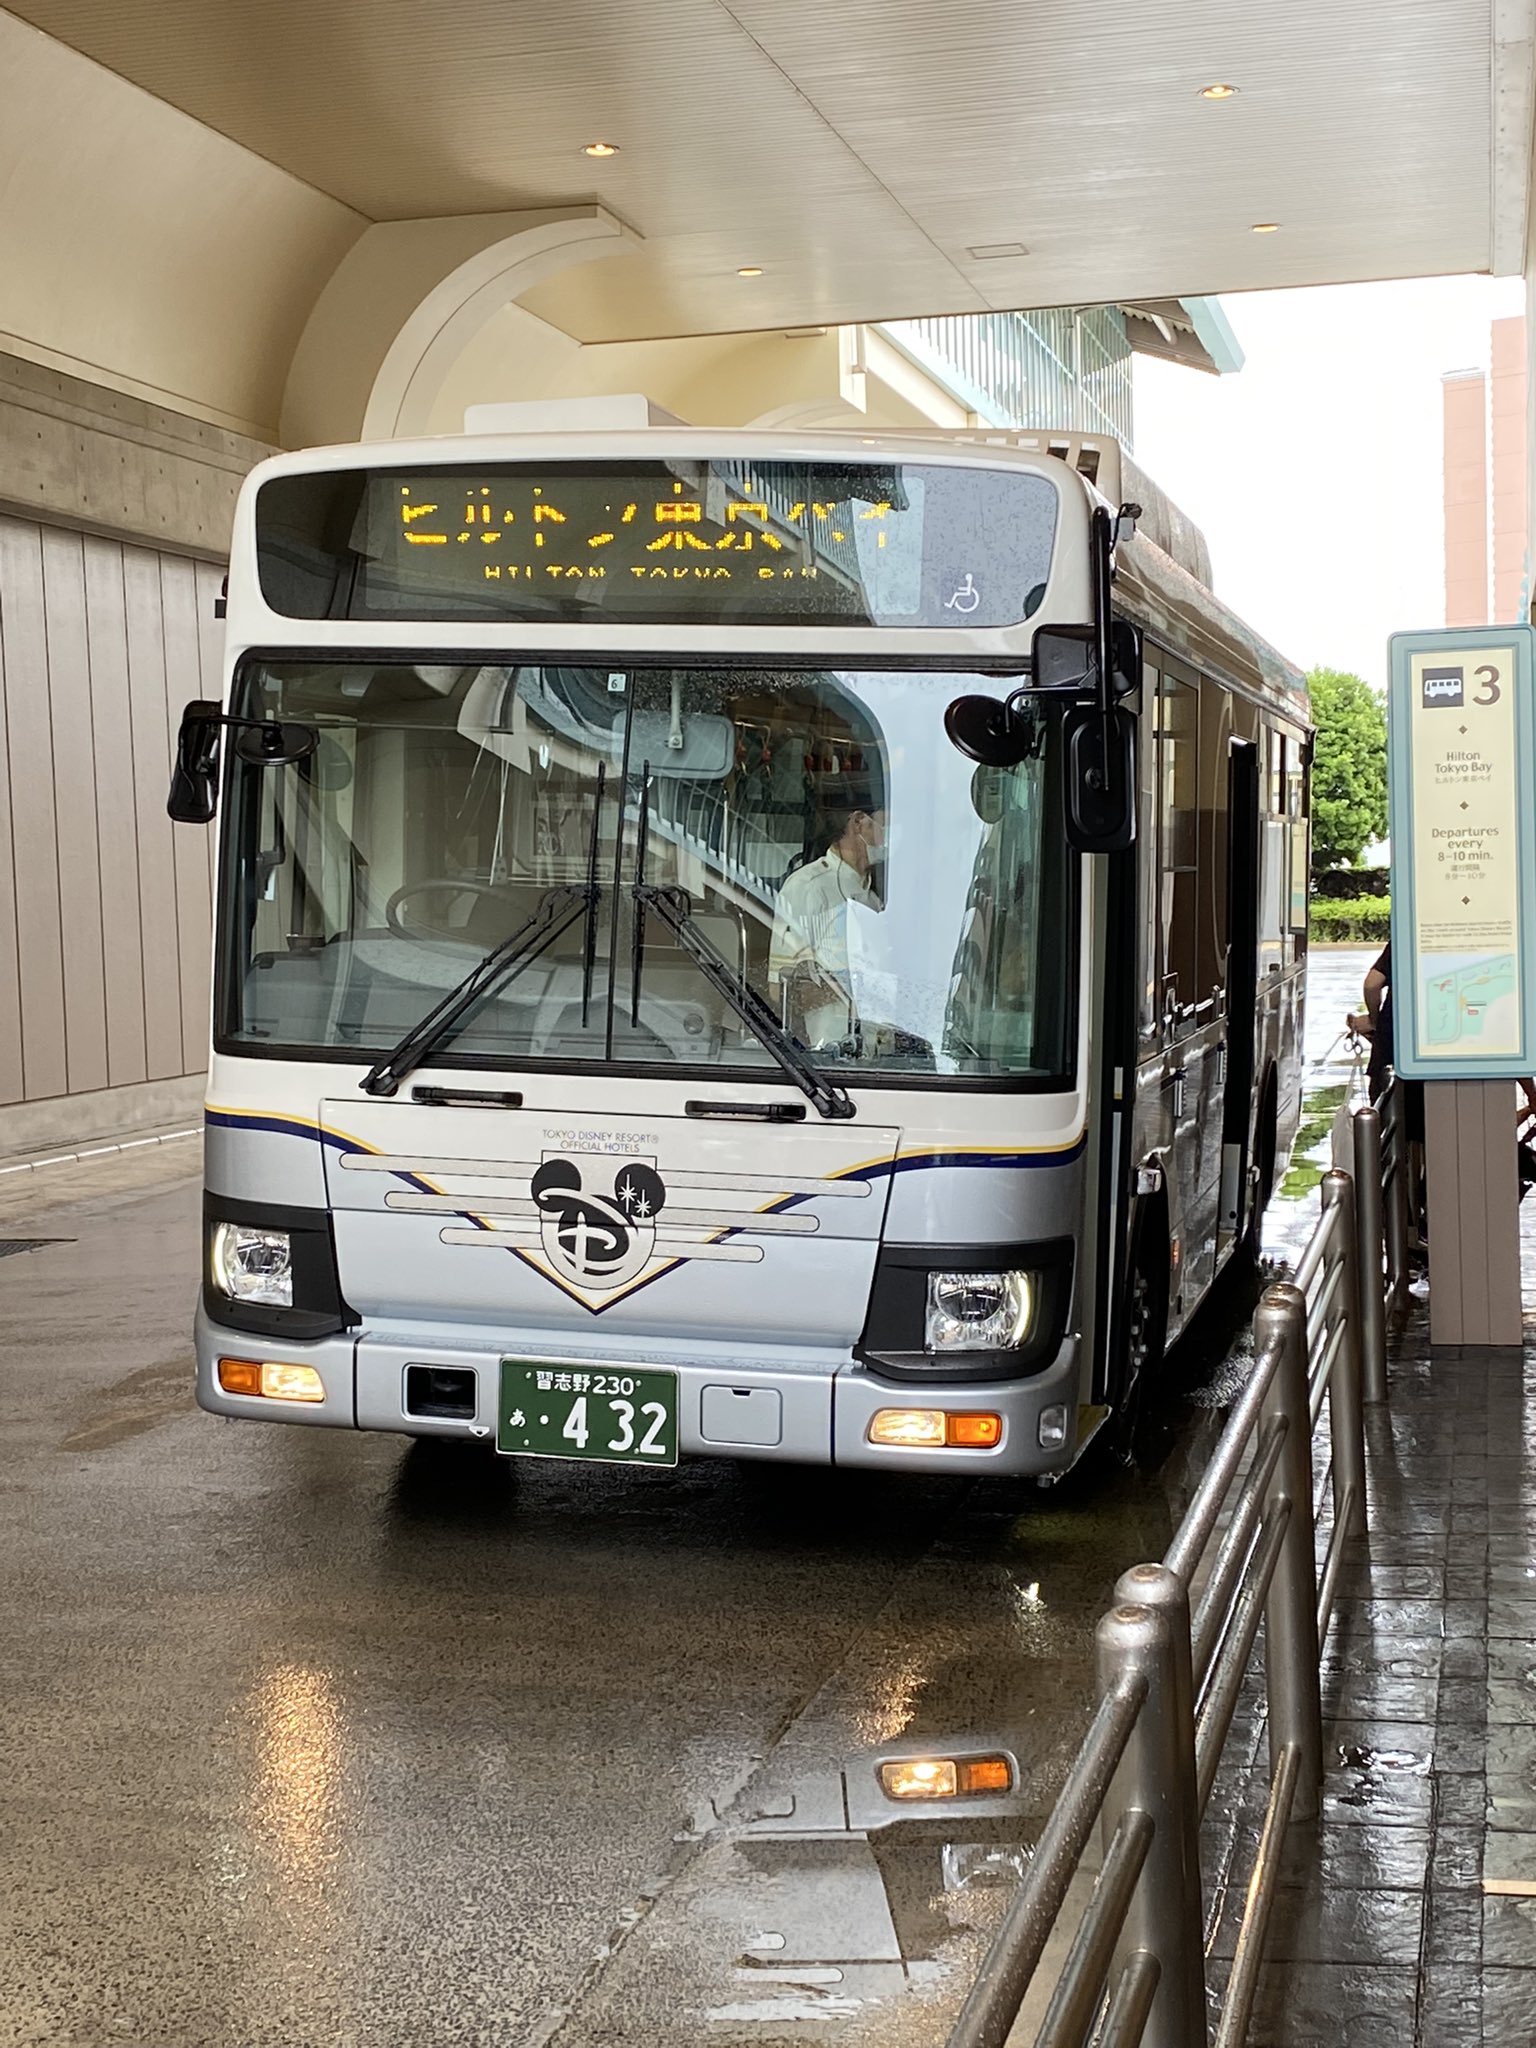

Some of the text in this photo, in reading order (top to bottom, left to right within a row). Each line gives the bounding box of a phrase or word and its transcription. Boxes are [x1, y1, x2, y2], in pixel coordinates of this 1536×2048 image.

[1472, 665, 1501, 706] 3
[1446, 751, 1481, 761] Hilton
[1434, 762, 1493, 774] Tokyo Bay
[1431, 827, 1500, 839] Departures
[1447, 839, 1484, 849] every
[1468, 850, 1494, 860] min.
[543, 1129, 576, 1139] TOKYO
[578, 1131, 612, 1141] DISNEY
[560, 1140, 640, 1153] OFFICIAL HOTELS
[509, 1408, 526, 1428] あ
